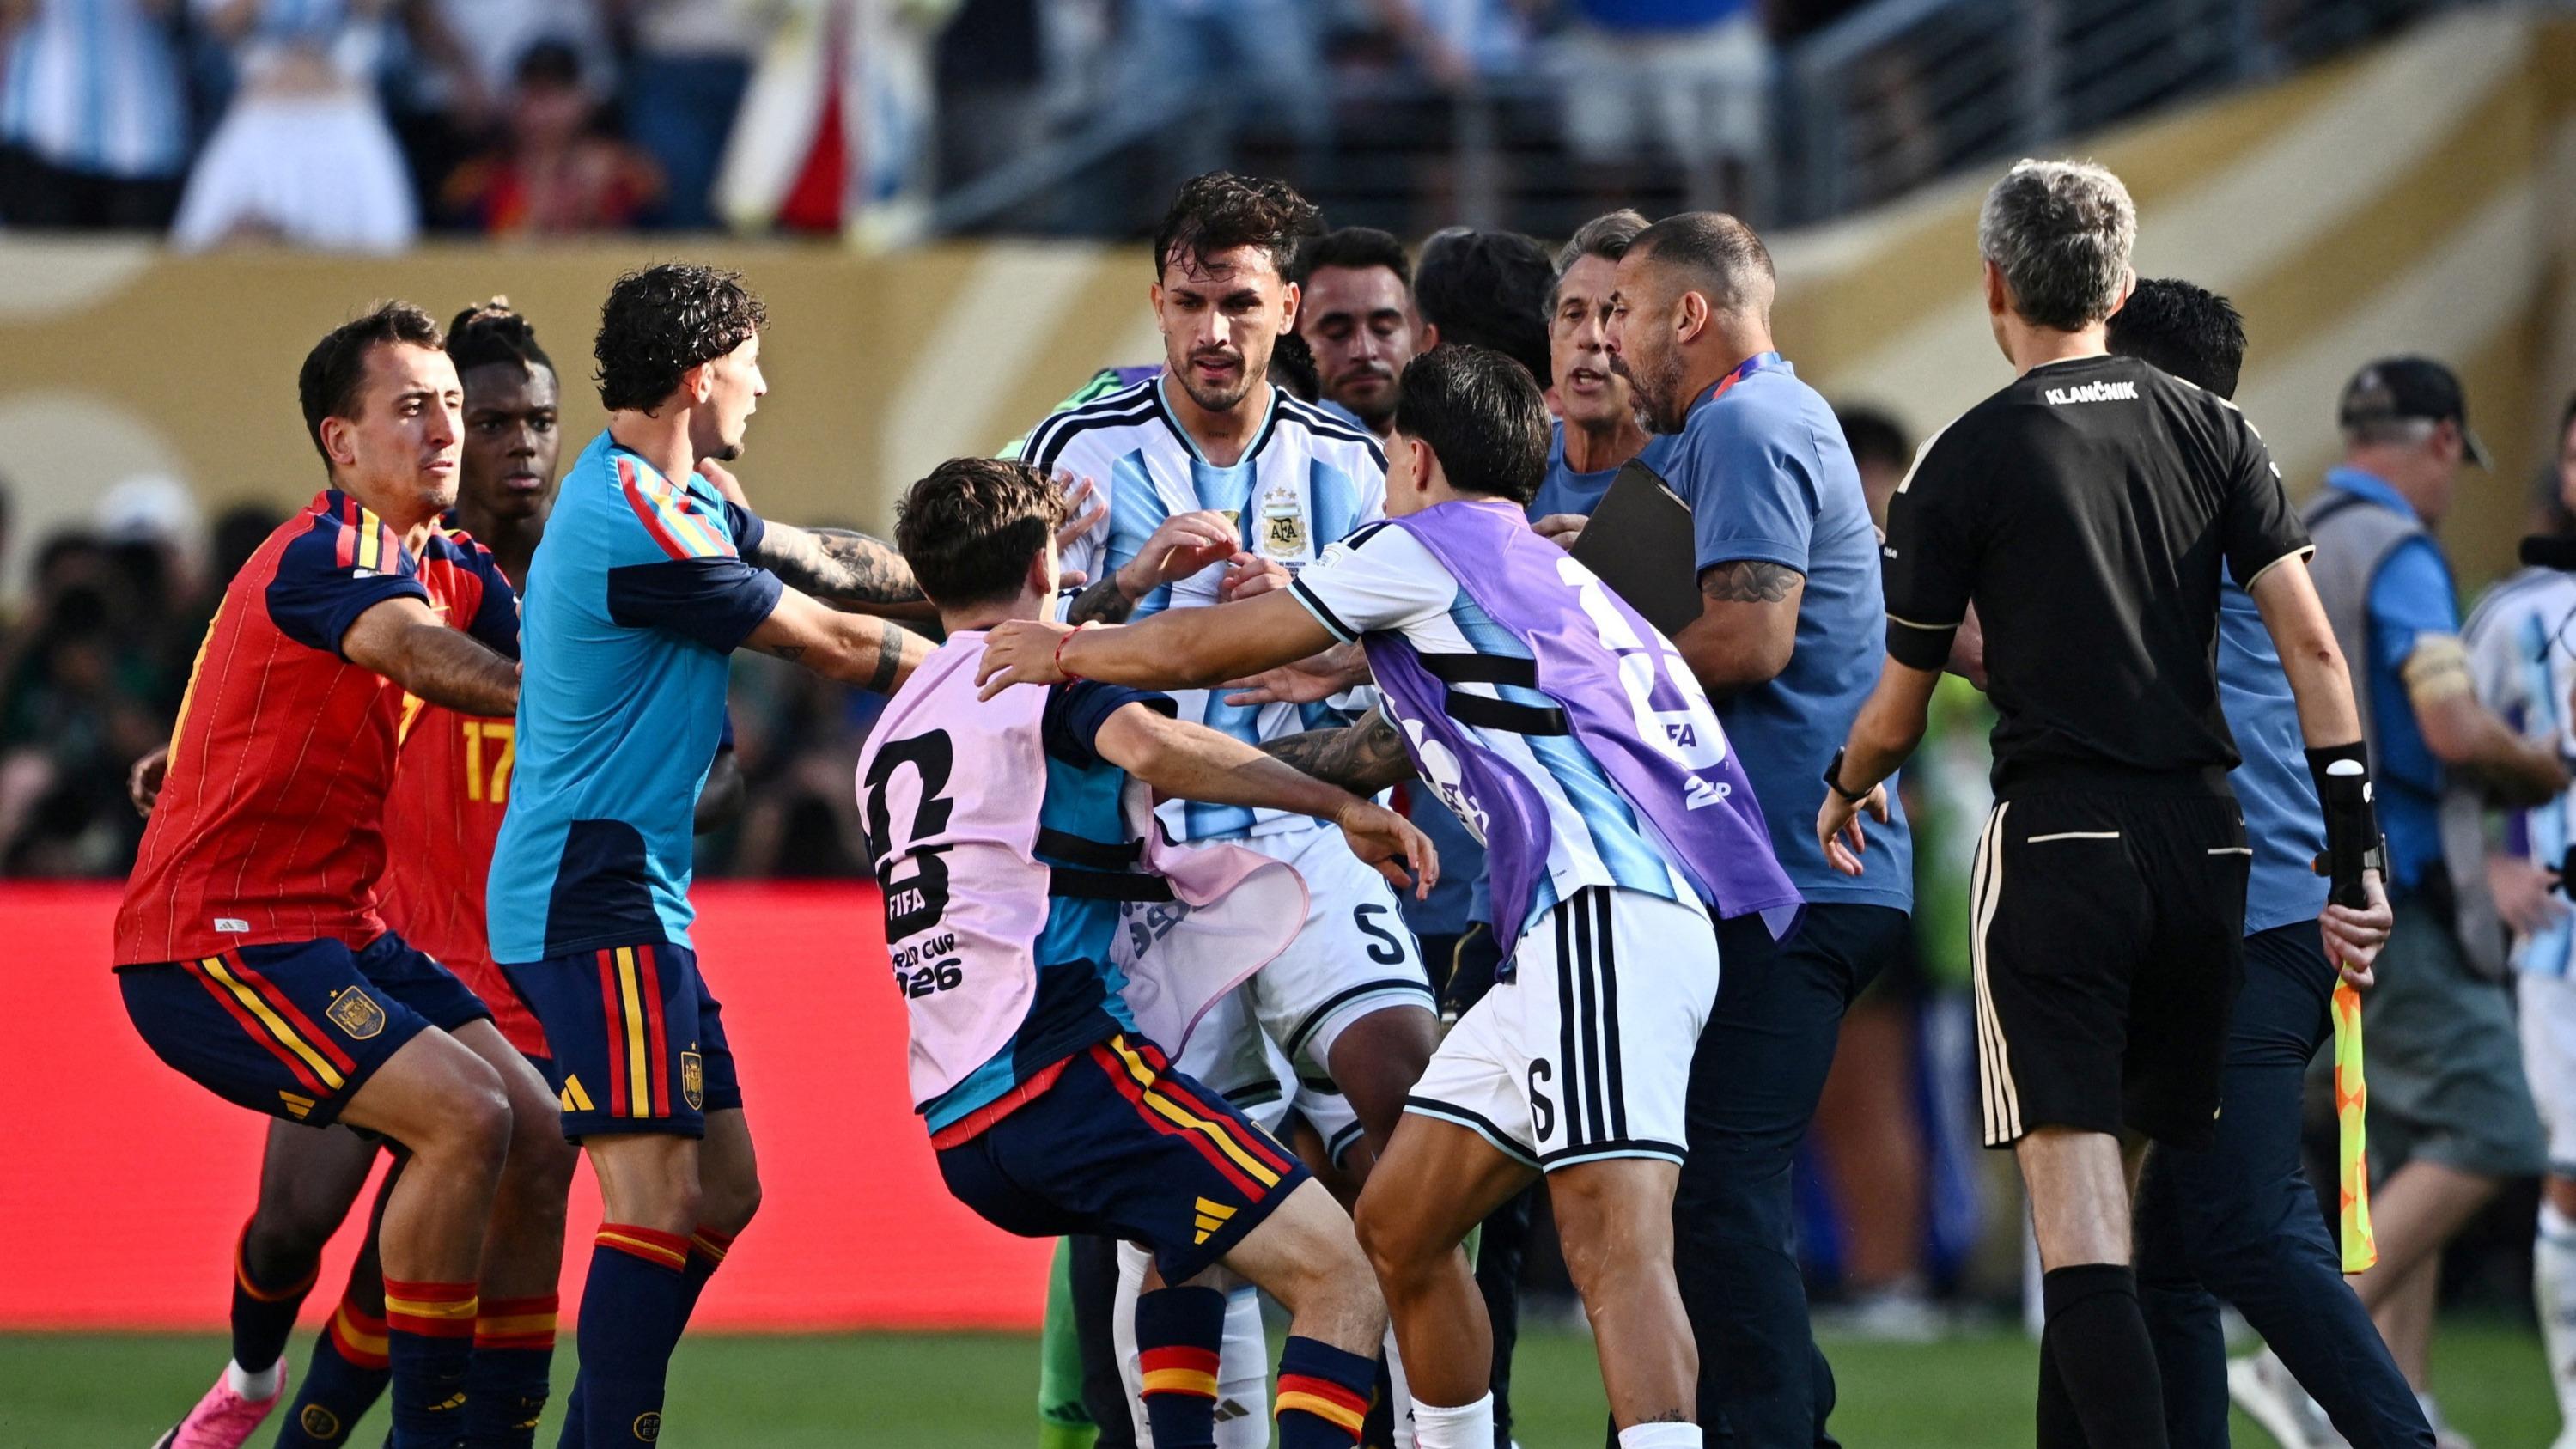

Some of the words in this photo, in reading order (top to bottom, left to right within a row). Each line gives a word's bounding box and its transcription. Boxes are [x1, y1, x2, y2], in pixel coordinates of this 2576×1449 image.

[2045, 381, 2139, 405] KLANČNIK
[1270, 517, 1297, 543] AFA
[1666, 723, 1697, 747] FA
[463, 721, 515, 803] 17
[889, 887, 926, 921] FIFA
[922, 933, 955, 959] CUP
